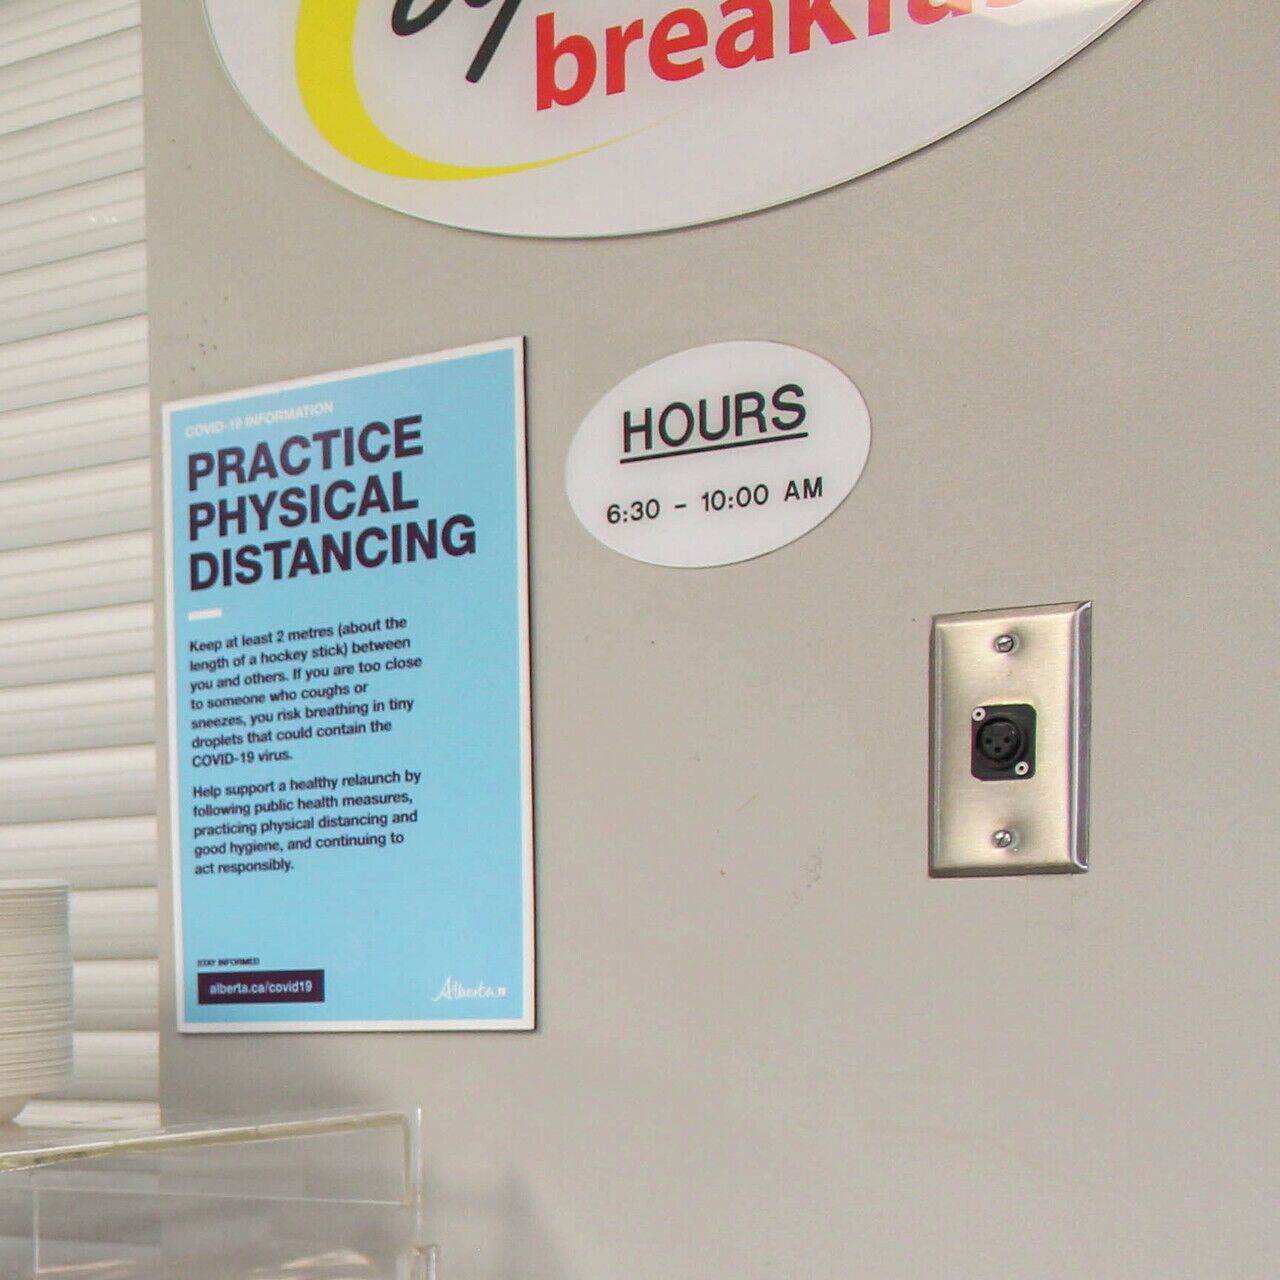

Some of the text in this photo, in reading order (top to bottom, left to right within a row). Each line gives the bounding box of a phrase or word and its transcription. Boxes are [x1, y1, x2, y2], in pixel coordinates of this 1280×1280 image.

[536, 0, 1025, 111] break
[185, 401, 334, 438] COVID-19 INFORMATION
[623, 384, 807, 453] HOURS
[188, 414, 423, 491] PRACTICE
[189, 471, 419, 541] PHYSICAL
[606, 498, 660, 524] 6:30
[701, 484, 769, 511] 10:00
[784, 476, 823, 501] AM
[190, 513, 476, 591] DISTANCING
[189, 616, 407, 652] Keep at least 2 metres (about the
[189, 637, 411, 672] length of a hockey stick) between
[190, 656, 422, 694] you and others. If you are too close
[190, 682, 369, 711] to someone who coughs or
[191, 696, 415, 730] sneezes, you risk breathing in tiny
[191, 719, 392, 750] droplets that could contain the
[192, 748, 293, 768] COVID-19 virus.
[193, 769, 421, 799] Help support a healthy relaunch by
[193, 792, 413, 817] following public health measures,
[194, 809, 418, 840] practicing physical distancing and
[194, 831, 404, 858] good hygiene, and continuing to
[194, 858, 294, 875] act responsibly.
[209, 980, 313, 995] alberta.ca/covid19
